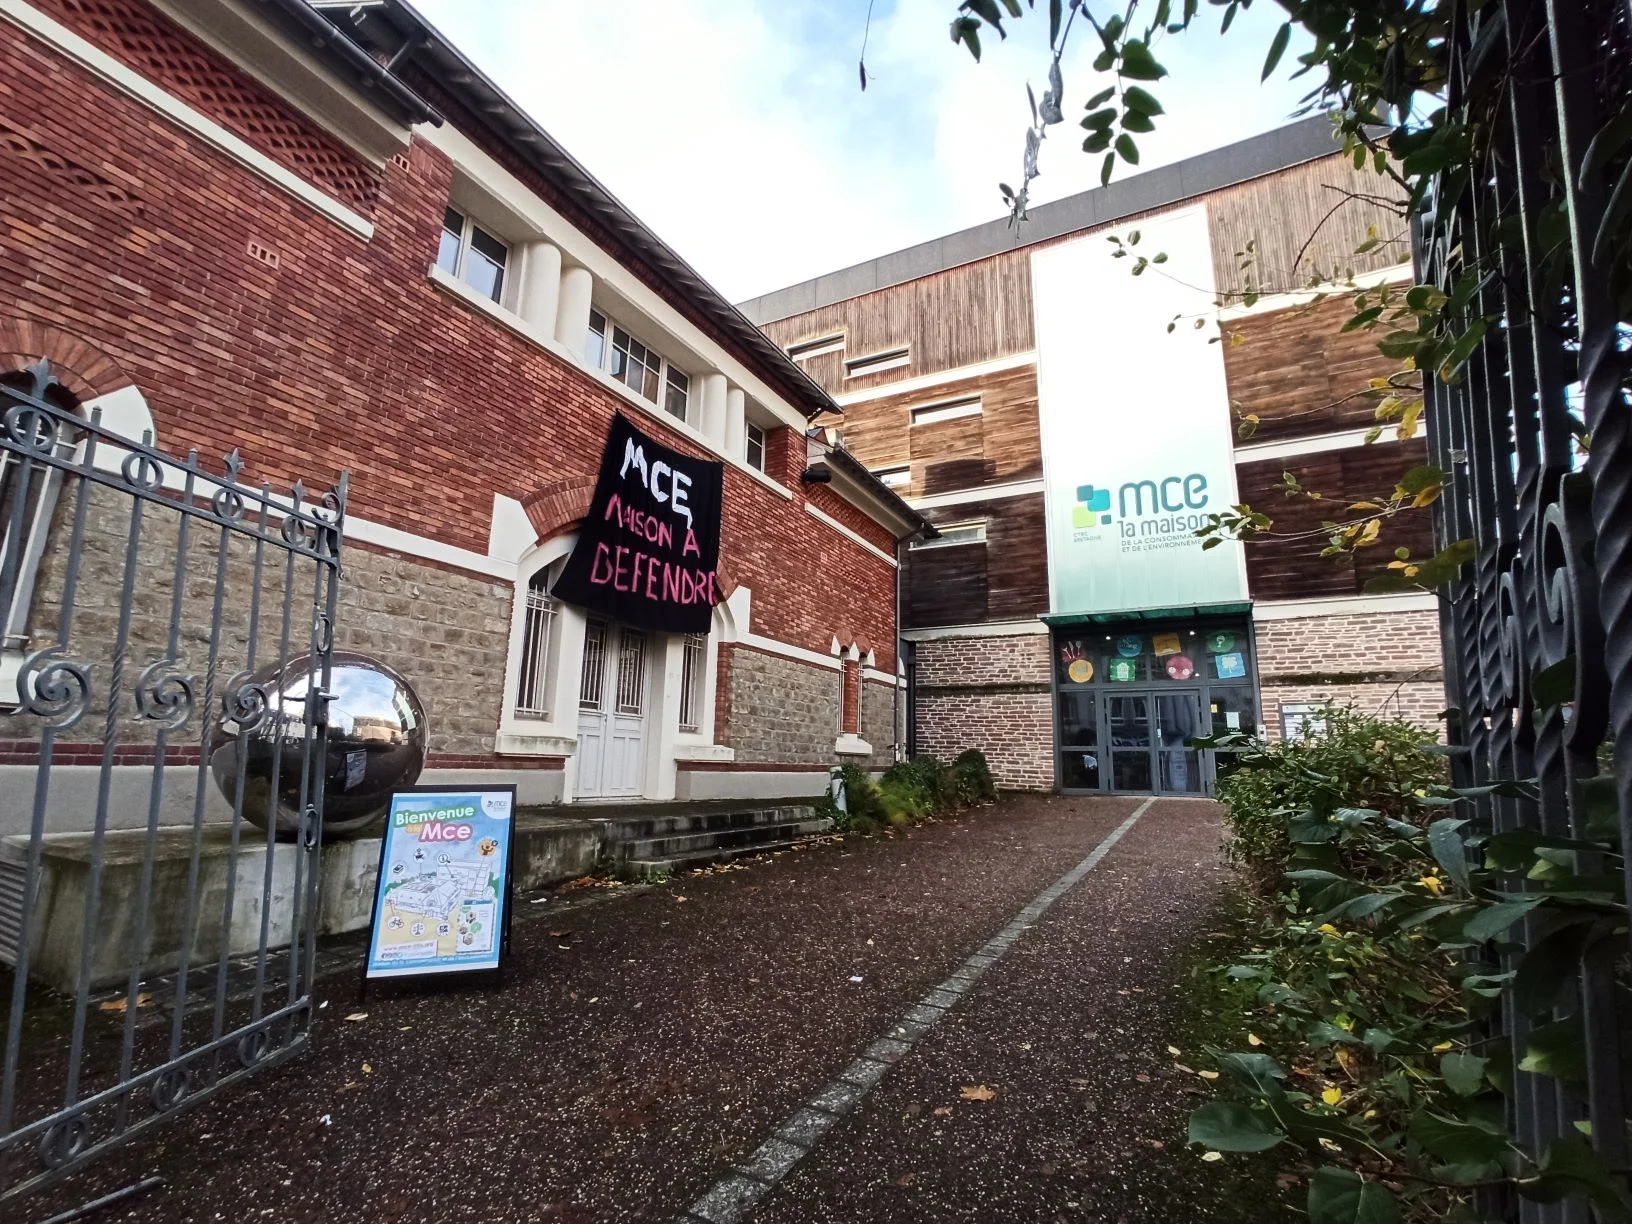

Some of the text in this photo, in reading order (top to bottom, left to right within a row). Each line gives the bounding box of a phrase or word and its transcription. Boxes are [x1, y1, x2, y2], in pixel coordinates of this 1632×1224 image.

[1118, 473, 1209, 518] mce
[1117, 513, 1210, 538] la maison
[682, 528, 701, 559] A
[1143, 538, 1204, 551] L'ENVIRONNEME
[1144, 533, 1197, 544] CONSOMMA
[590, 541, 717, 606] DEFENDRE
[395, 806, 475, 825] Bienvenue
[421, 822, 472, 841] Mce
